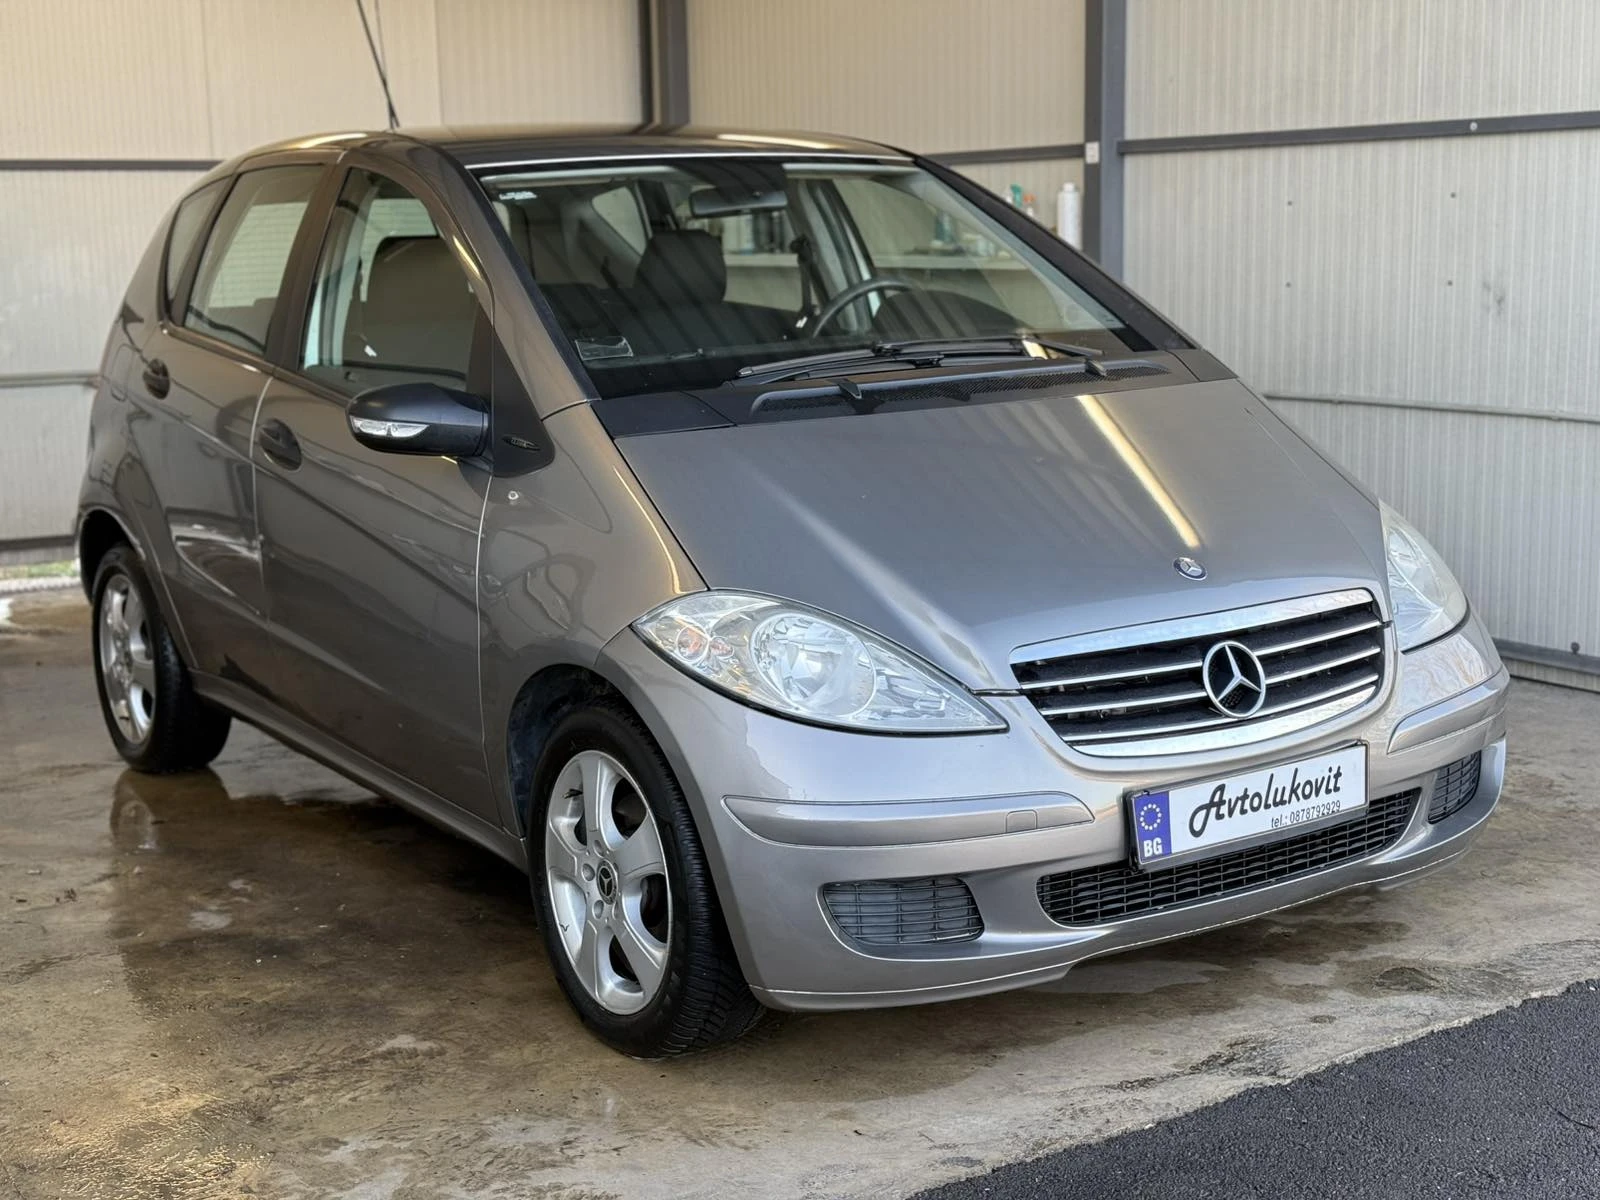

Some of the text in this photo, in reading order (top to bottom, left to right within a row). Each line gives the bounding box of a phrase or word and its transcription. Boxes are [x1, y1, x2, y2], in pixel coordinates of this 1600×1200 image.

[1188, 765, 1343, 838] Avtolukovit
[1271, 800, 1341, 829] tel.: 0878792929
[1143, 837, 1163, 858] BG
